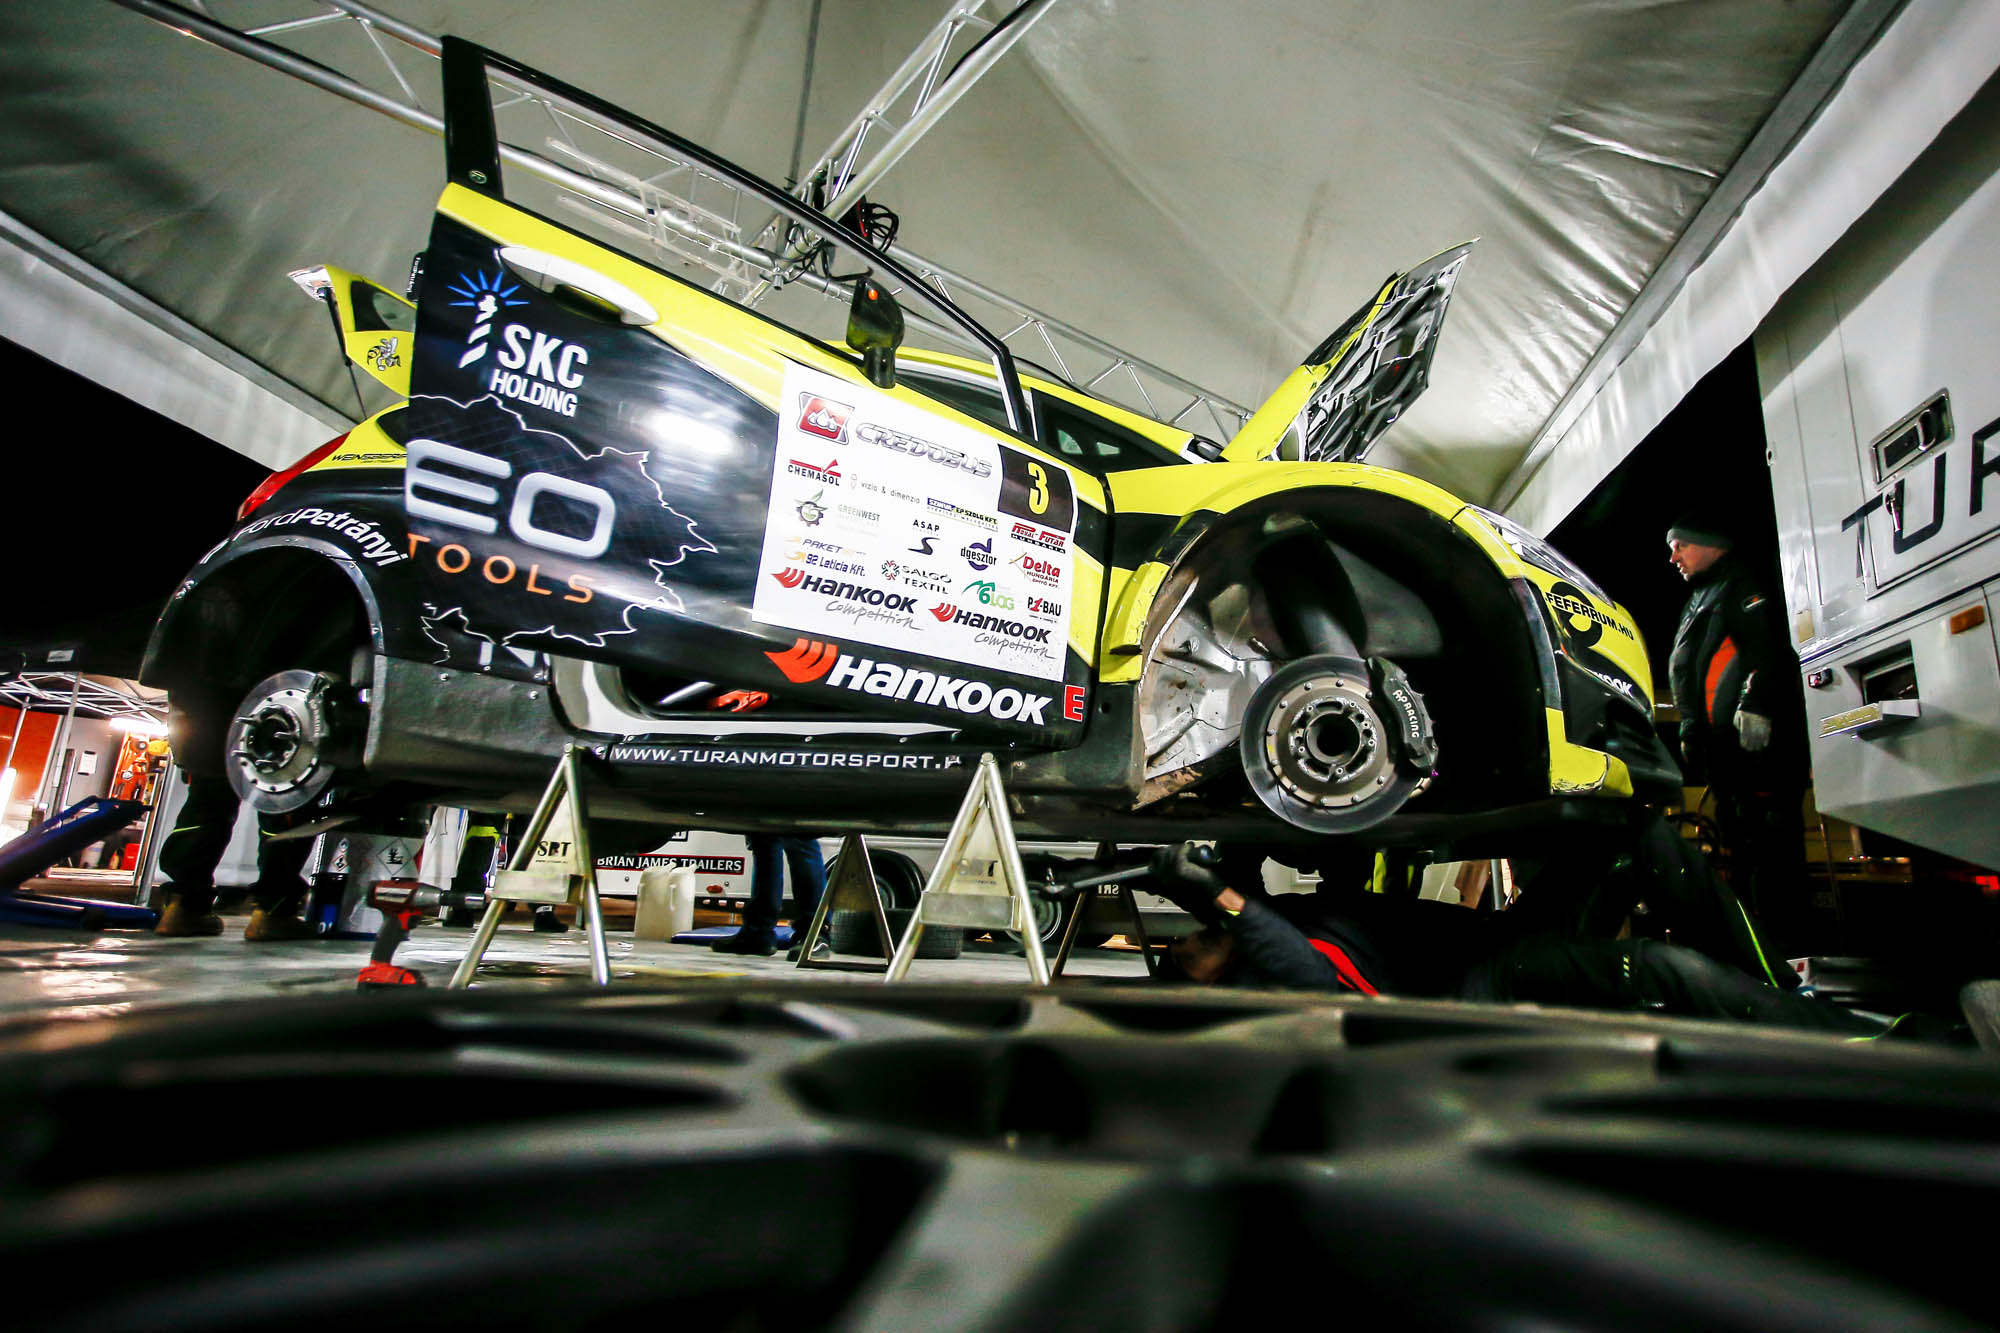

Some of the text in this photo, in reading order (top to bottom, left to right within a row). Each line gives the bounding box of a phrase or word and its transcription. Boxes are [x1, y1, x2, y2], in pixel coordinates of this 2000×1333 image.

[497, 323, 589, 390] SKC
[489, 368, 578, 418] HOLDING
[856, 422, 993, 478] CREDOBUS
[787, 464, 840, 487] CHEMASOL
[1027, 461, 1049, 515] 3
[881, 486, 887, 494] &
[912, 519, 940, 532] ASAP
[407, 533, 595, 604] TOOLS
[805, 553, 866, 577] 92 Leticia Kft.
[1022, 555, 1061, 578] Delta
[901, 577, 949, 595] TEXTIL
[825, 600, 925, 631] Competition
[974, 632, 1056, 659] Competition
[1063, 684, 1086, 723] E
[597, 856, 635, 867] BRIAN
